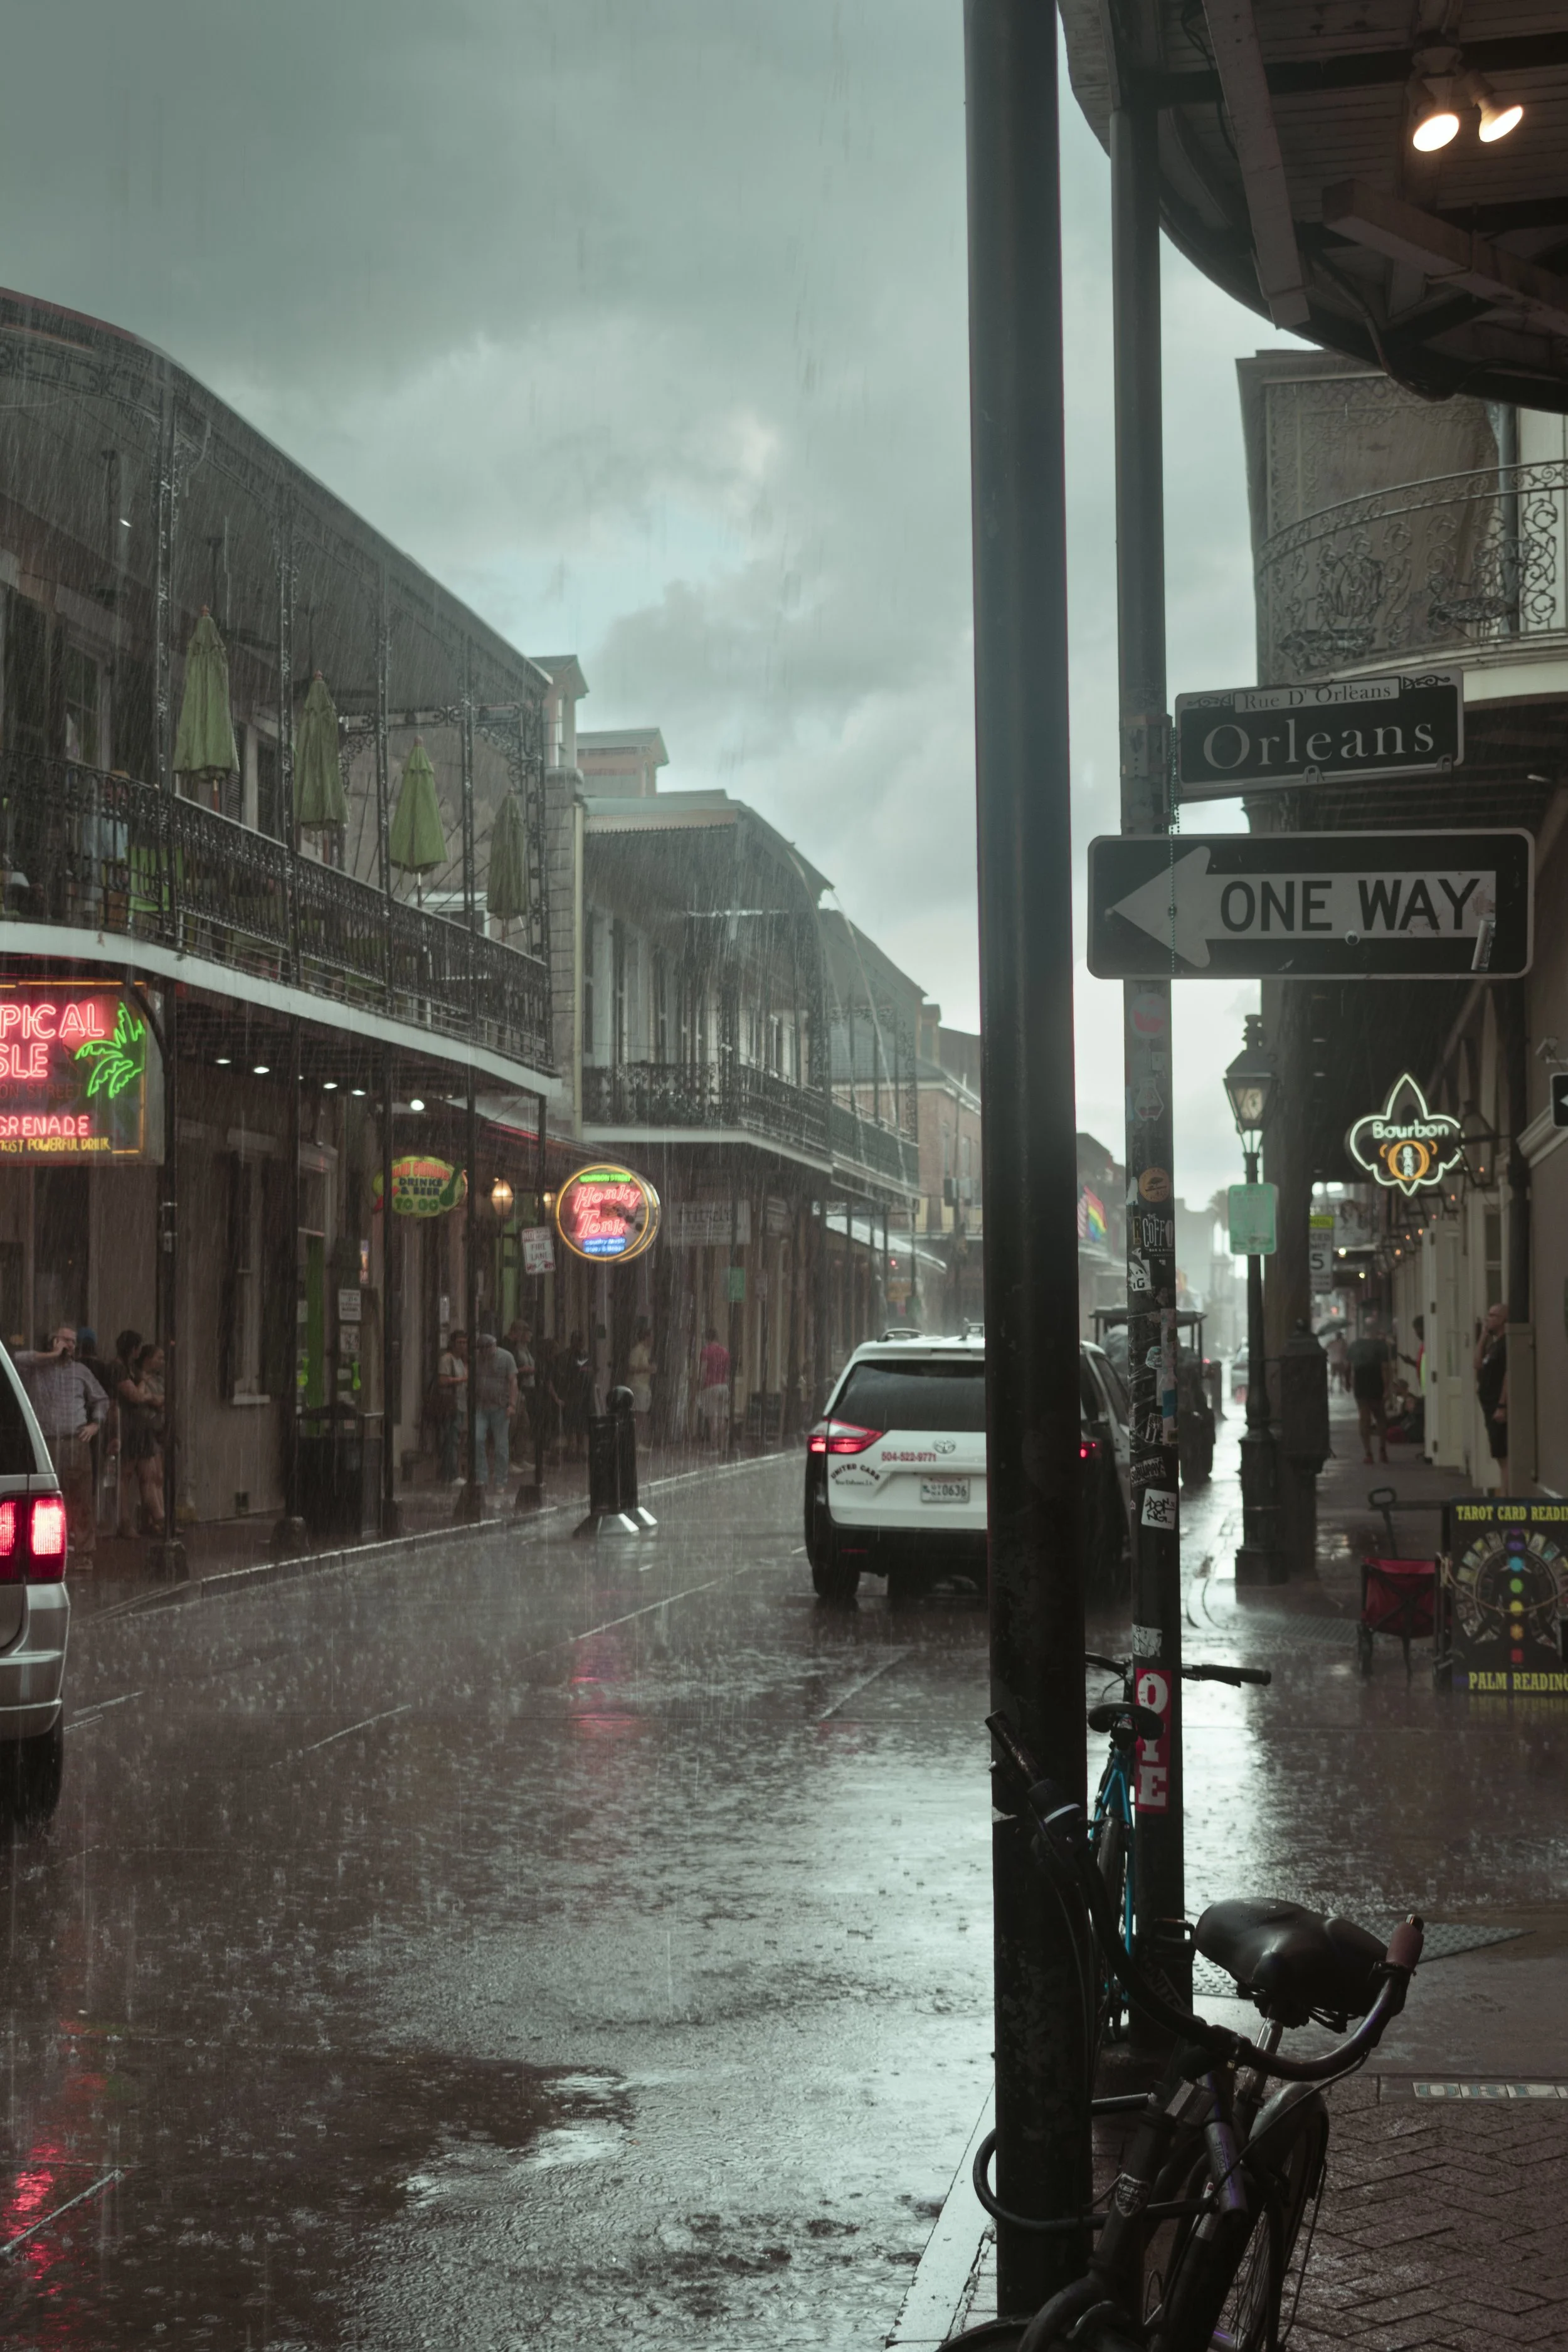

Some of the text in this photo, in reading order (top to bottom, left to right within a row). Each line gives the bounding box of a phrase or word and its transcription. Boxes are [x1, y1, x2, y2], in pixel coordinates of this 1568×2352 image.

[1244, 694, 1279, 710] Rue
[1203, 718, 1435, 770] Orleans
[1220, 878, 1481, 933] ONE WAY
[27, 1084, 83, 1099] STREET
[1372, 1119, 1449, 1138] Bourbon
[28, 1136, 79, 1152] POWERFUL
[81, 1137, 110, 1151] DRINK
[400, 1178, 442, 1187] DRINKS
[395, 1198, 439, 1210] TO GO
[573, 1184, 640, 1214] Honky
[578, 1210, 626, 1238] Tonk
[532, 1252, 547, 1261] LANE
[1311, 1253, 1324, 1270] 5
[882, 1451, 936, 1462] 504-522-9771
[831, 1463, 880, 1480] UNITED CABS
[942, 1484, 967, 1496] 0636
[1456, 1505, 1494, 1521] TAROT
[1498, 1505, 1527, 1521] CARD
[1468, 1671, 1508, 1691] PALM
[1417, 2083, 1568, 2098] ORL
